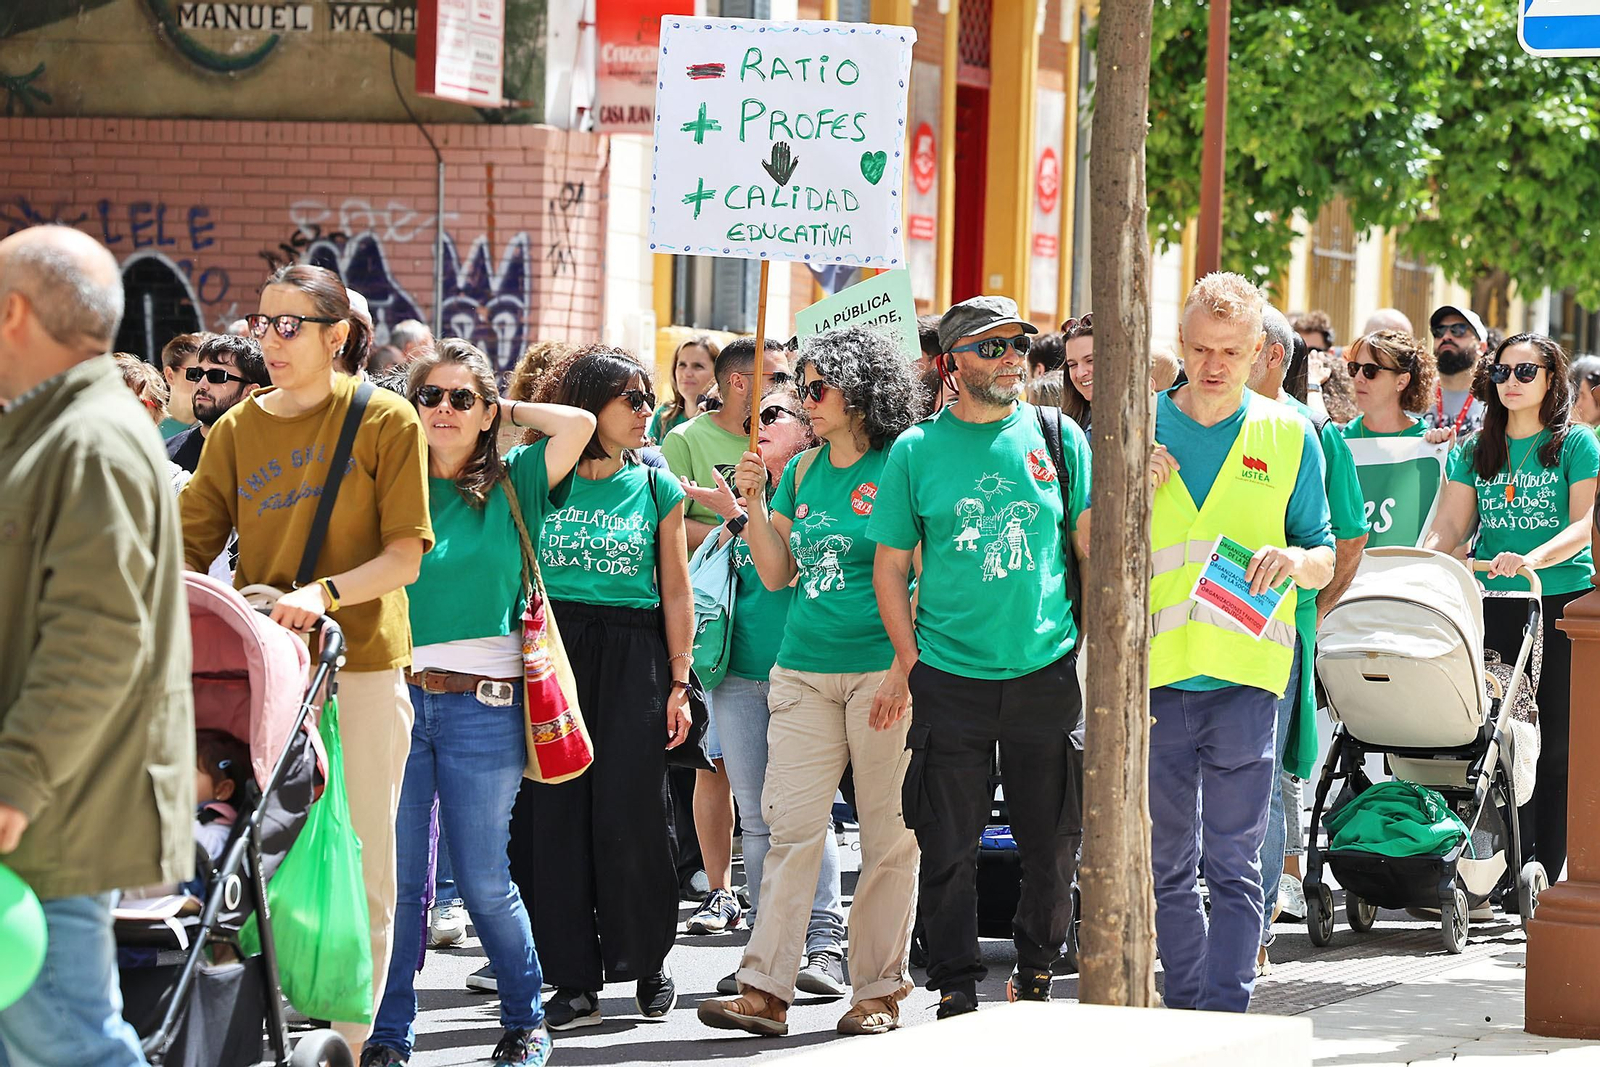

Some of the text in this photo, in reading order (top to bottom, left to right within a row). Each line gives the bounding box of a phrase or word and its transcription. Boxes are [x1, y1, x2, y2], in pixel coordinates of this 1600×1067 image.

[178, 4, 308, 30] MANUEL
[601, 104, 651, 124] CASA JUAN
[739, 98, 867, 143] PROFES
[815, 292, 891, 334] LA PÚBLICA
[1242, 470, 1270, 482] USTEA
[1482, 497, 1500, 511] DE
[549, 534, 573, 549] DE
